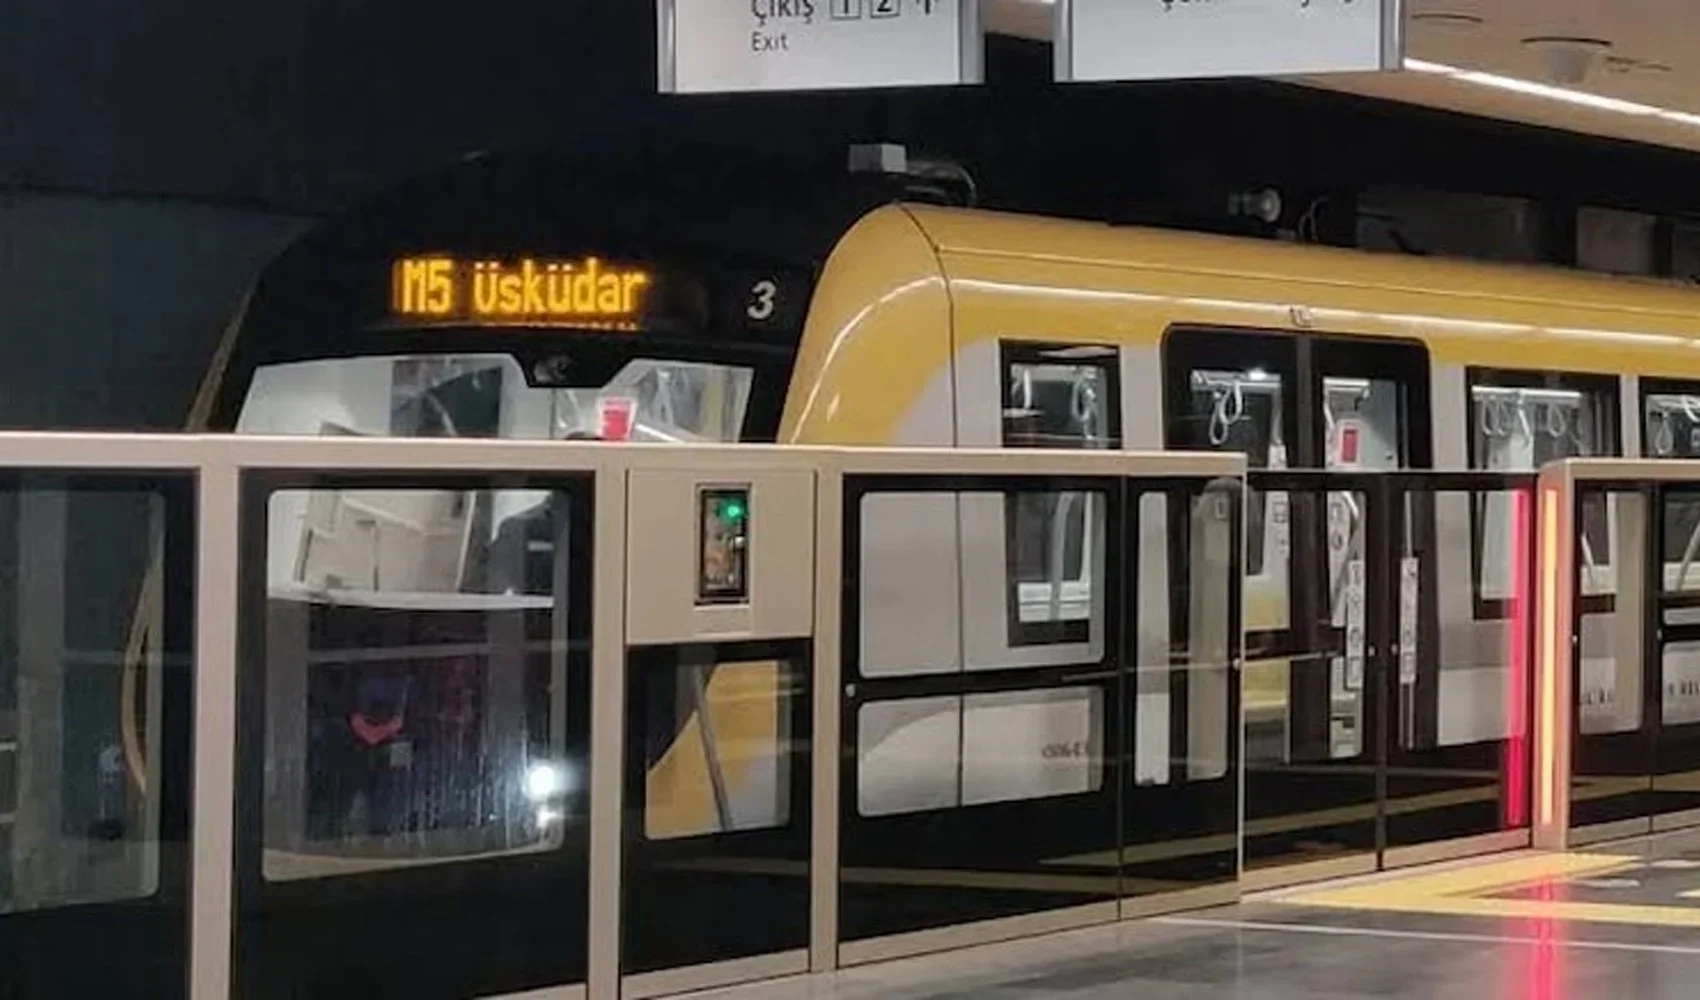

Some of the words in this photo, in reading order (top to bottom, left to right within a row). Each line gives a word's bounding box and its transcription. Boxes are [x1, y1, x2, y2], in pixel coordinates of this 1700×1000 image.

[752, 33, 787, 51] Exit
[402, 258, 453, 314] M5
[747, 280, 776, 320] 3
